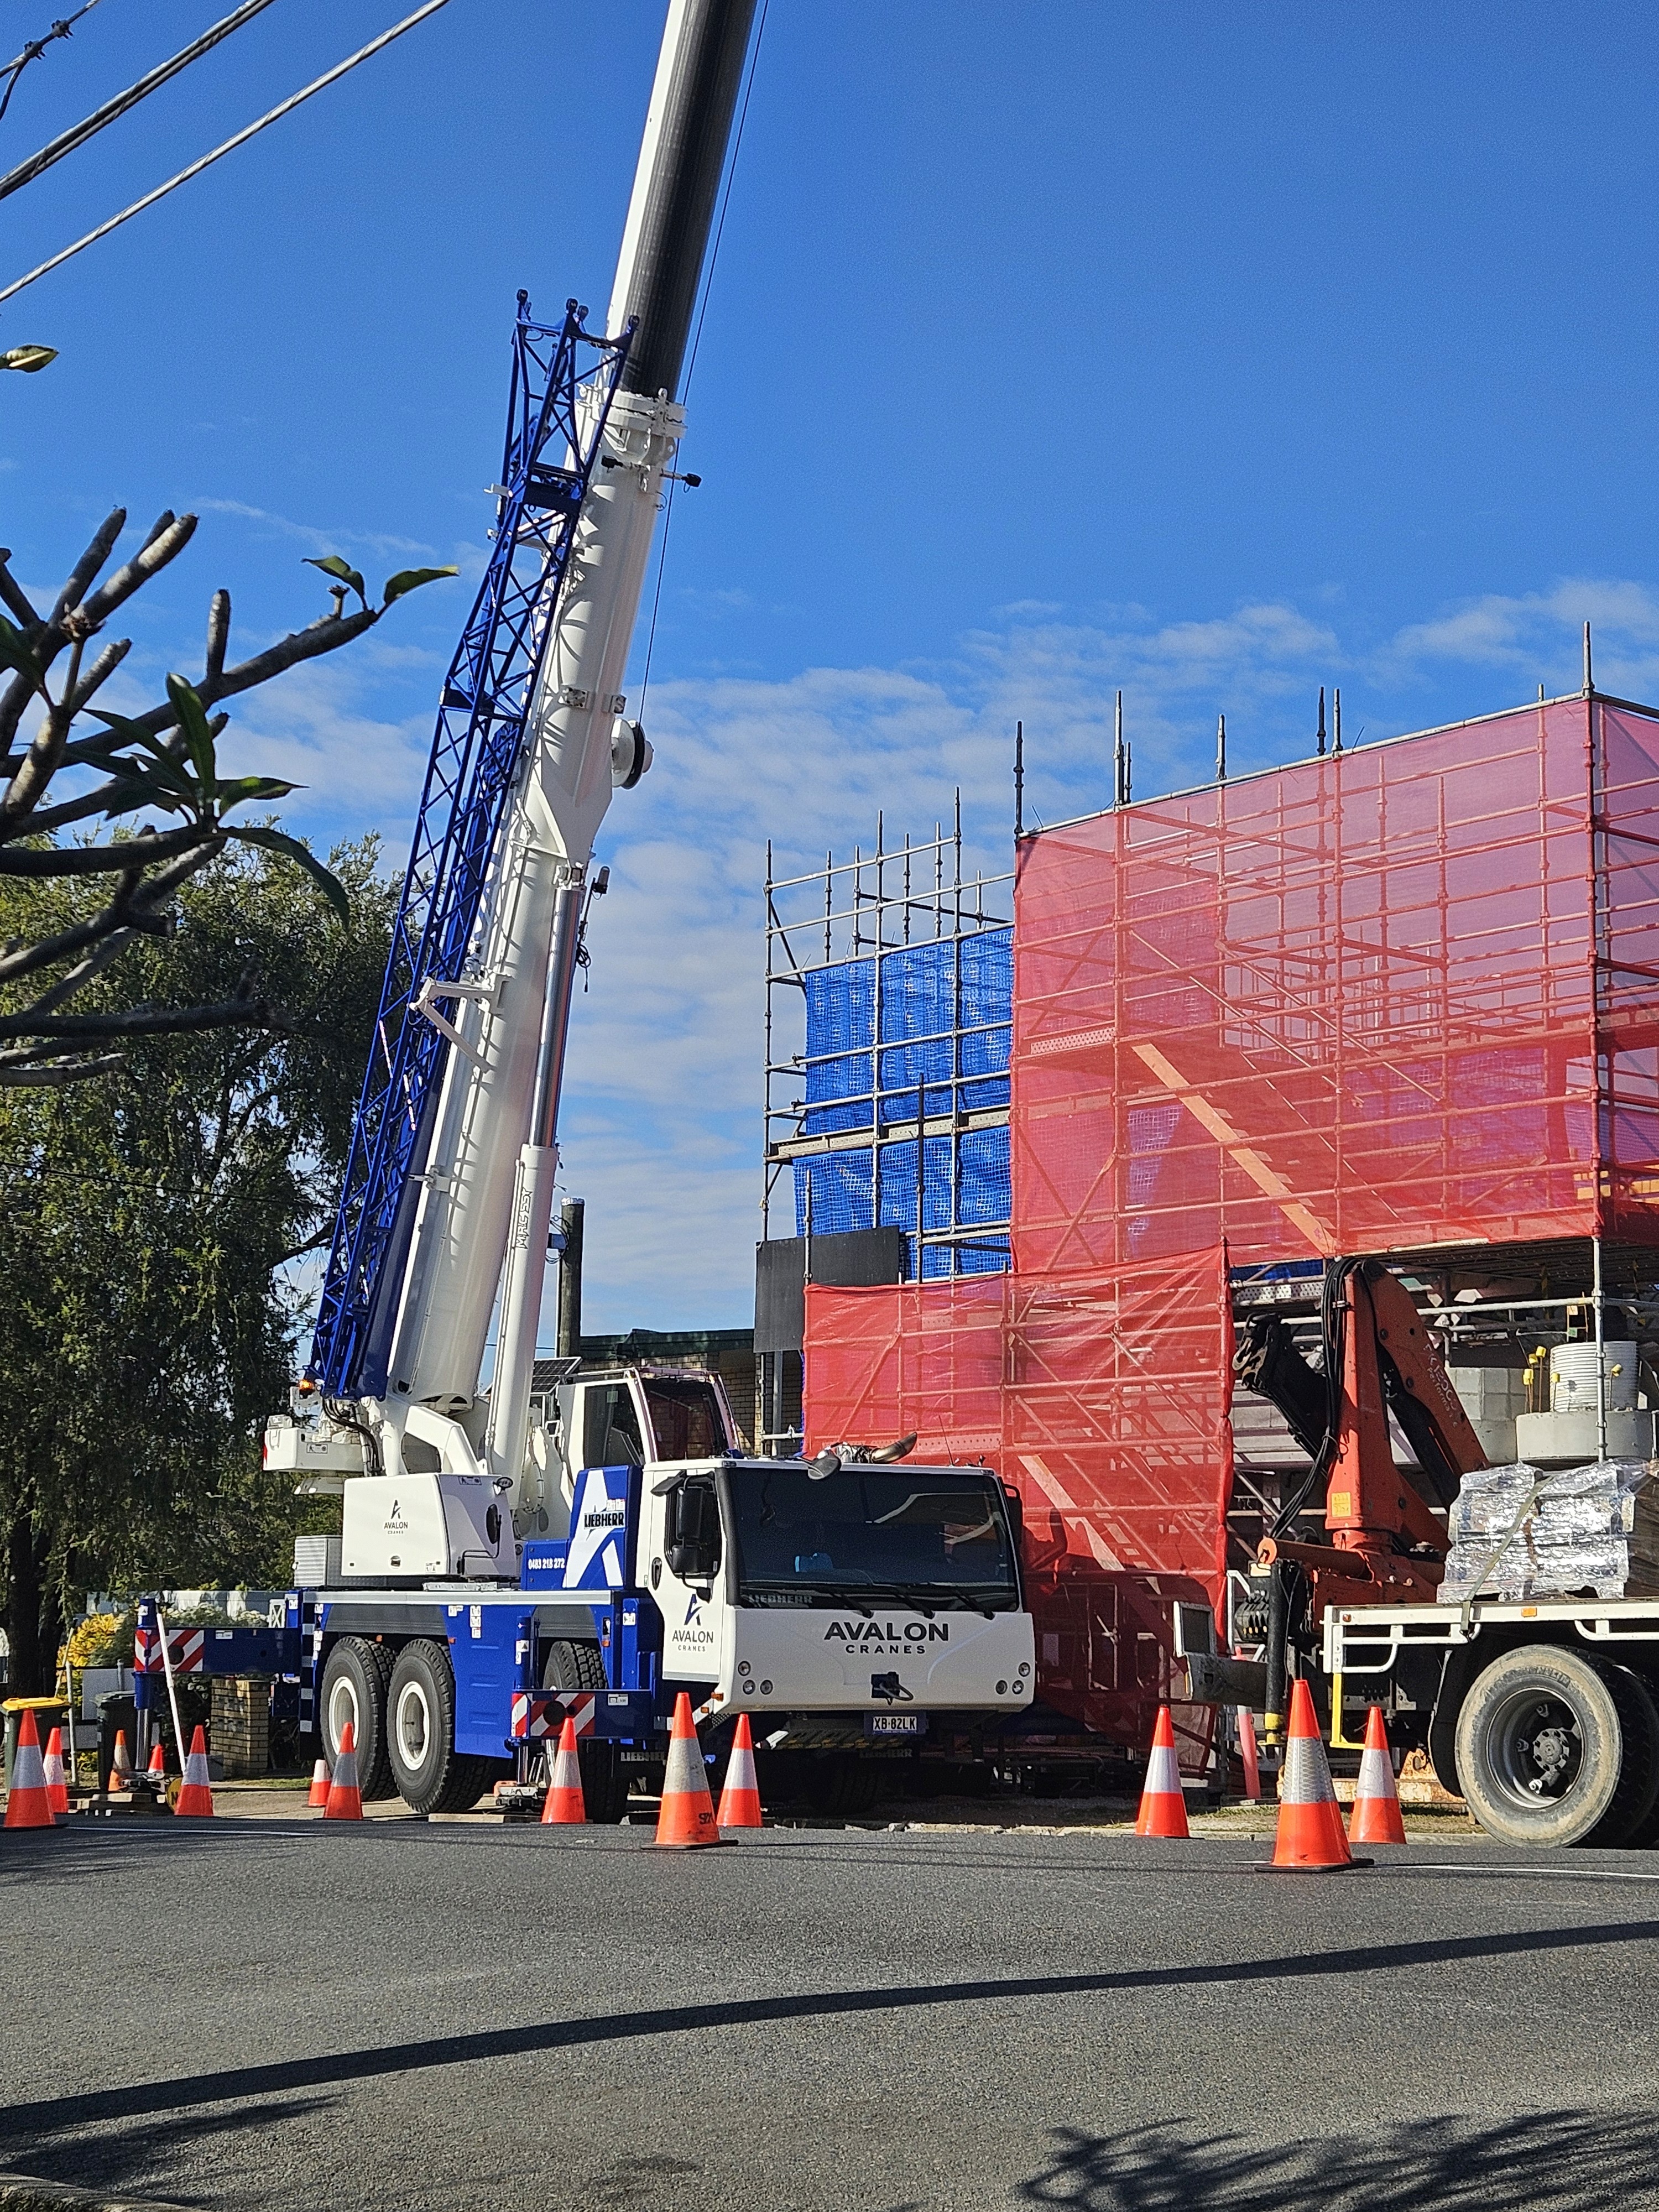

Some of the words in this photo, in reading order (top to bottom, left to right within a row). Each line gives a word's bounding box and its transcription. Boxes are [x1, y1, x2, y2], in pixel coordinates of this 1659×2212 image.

[1427, 1367, 1458, 1428] Performae
[584, 1512, 624, 1528] LIEBHERR
[528, 1558, 541, 1569] 0483
[554, 1557, 565, 1569] 272
[748, 1594, 813, 1604] LIEBHERR
[672, 1630, 713, 1644] AVALON
[824, 1622, 949, 1641] AVALON
[845, 1645, 926, 1654] CRANES
